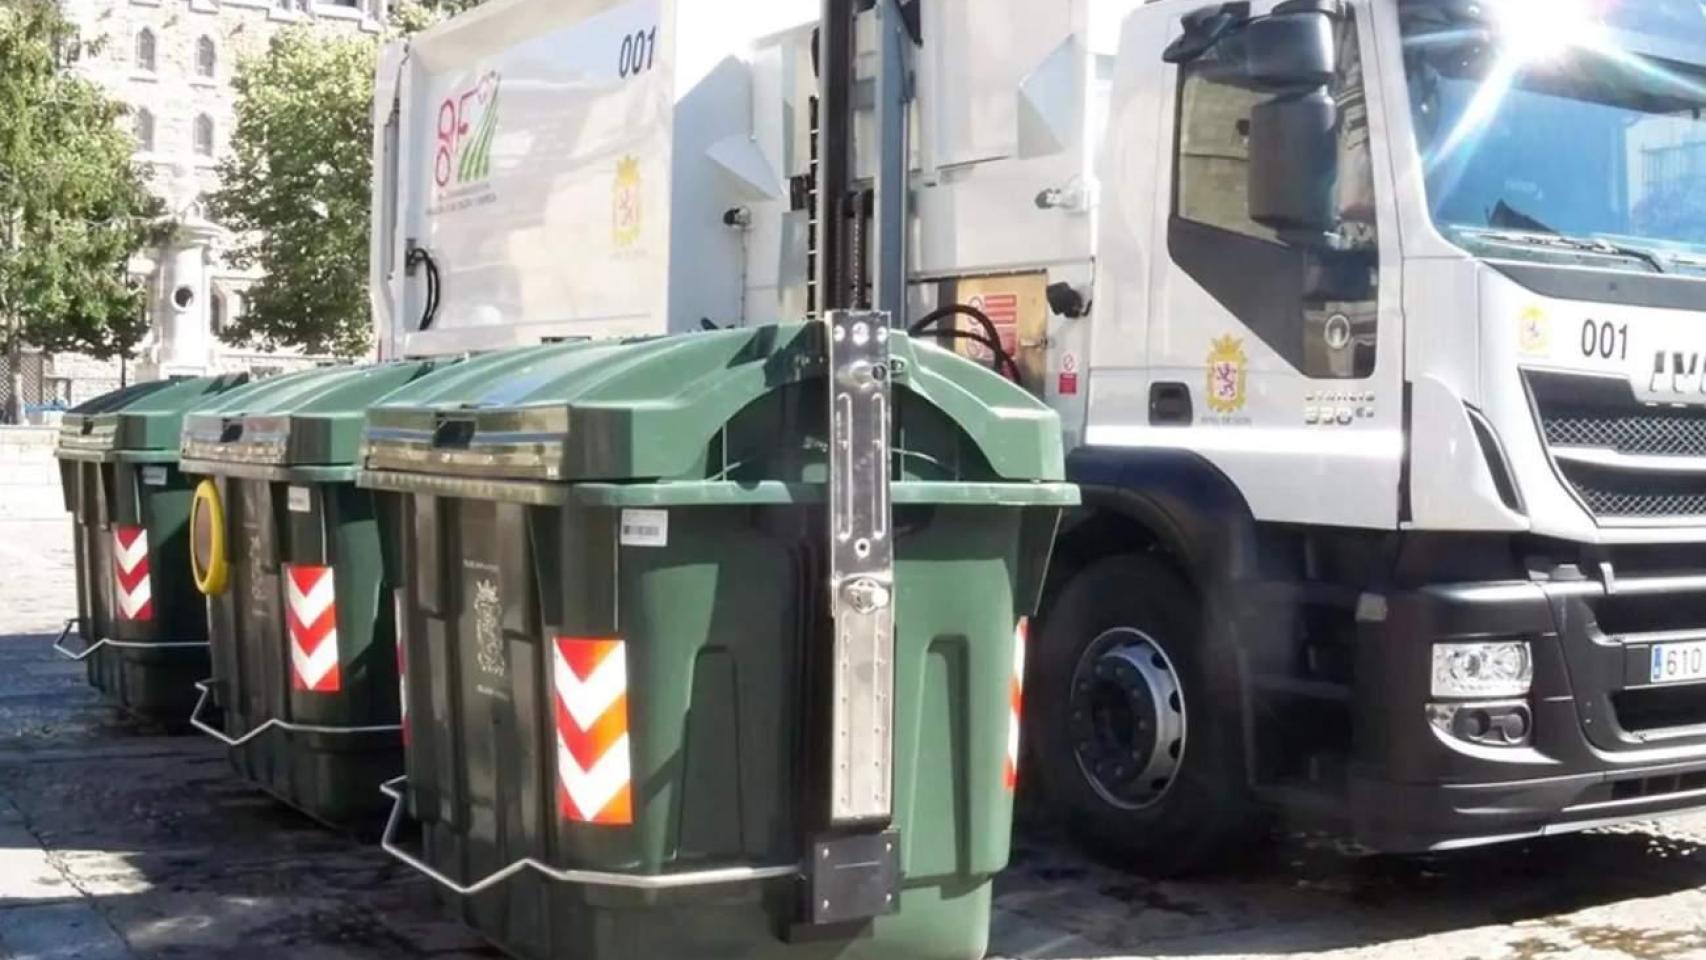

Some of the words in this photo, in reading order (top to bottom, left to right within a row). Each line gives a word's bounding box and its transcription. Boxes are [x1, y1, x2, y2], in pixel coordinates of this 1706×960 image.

[617, 26, 657, 79] 001
[1581, 318, 1629, 361] 001
[1648, 350, 1706, 393] IV
[1666, 647, 1702, 676] 610
